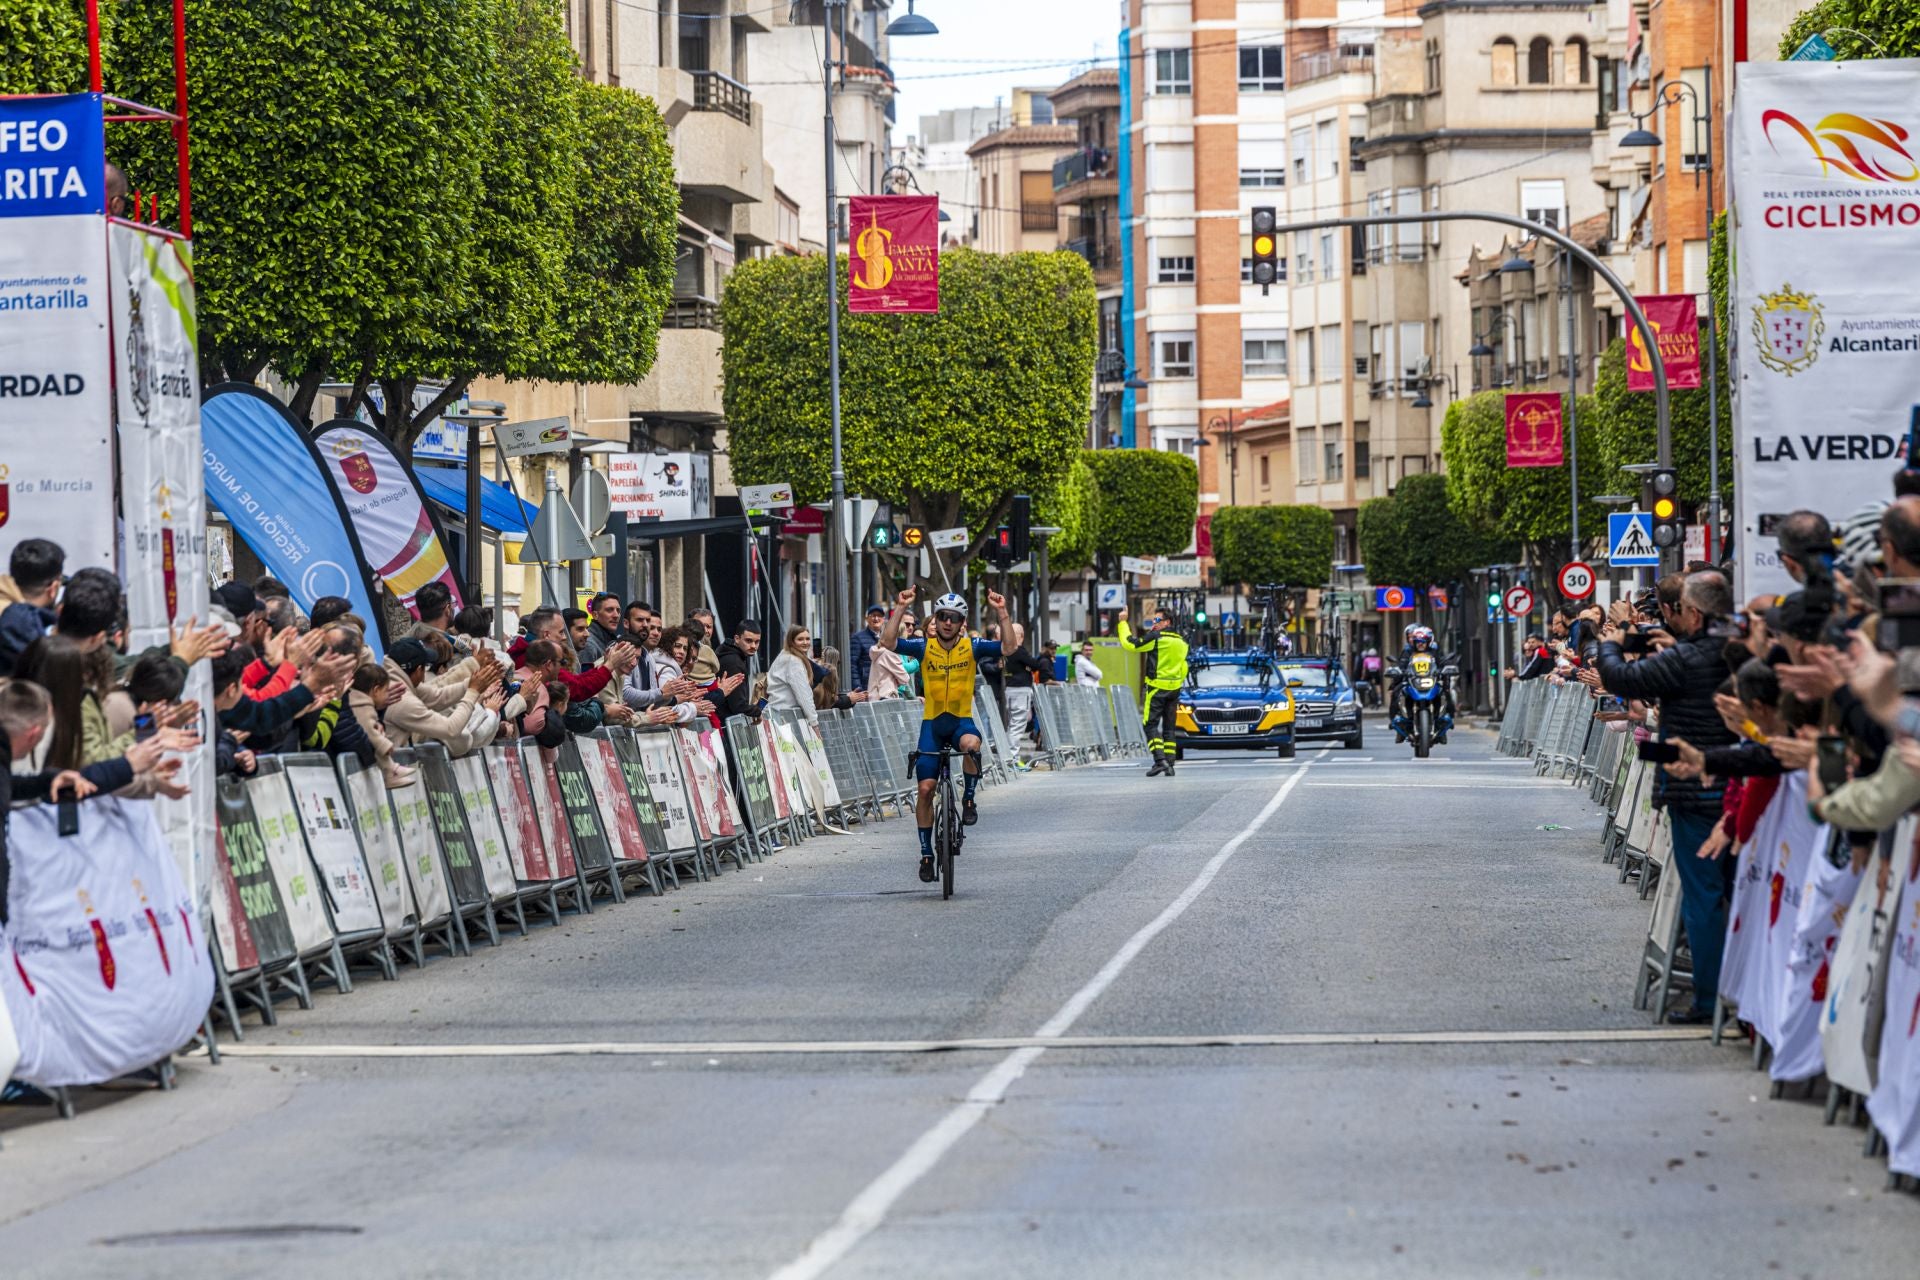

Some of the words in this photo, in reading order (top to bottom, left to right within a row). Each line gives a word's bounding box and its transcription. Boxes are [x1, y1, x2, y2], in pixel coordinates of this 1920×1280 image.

[0, 166, 88, 200] RITA
[1763, 191, 1789, 199] REAL
[1793, 188, 1861, 198] FEDERACIÓN
[1764, 202, 1920, 228] CICLISMO
[73, 275, 87, 285] de
[1754, 435, 1799, 462] LA
[610, 461, 638, 472] LIBRERÍA
[15, 480, 34, 493] de
[40, 478, 93, 492] Murcia
[610, 477, 644, 487] PAPELERÍA
[611, 493, 654, 503] MERCHANDISE
[647, 509, 664, 518] MESA
[1156, 563, 1198, 577] FARMACIA
[1567, 574, 1587, 587] 30
[1417, 662, 1427, 671] M
[1213, 725, 1231, 734] 4123
[1232, 724, 1247, 733] LVP
